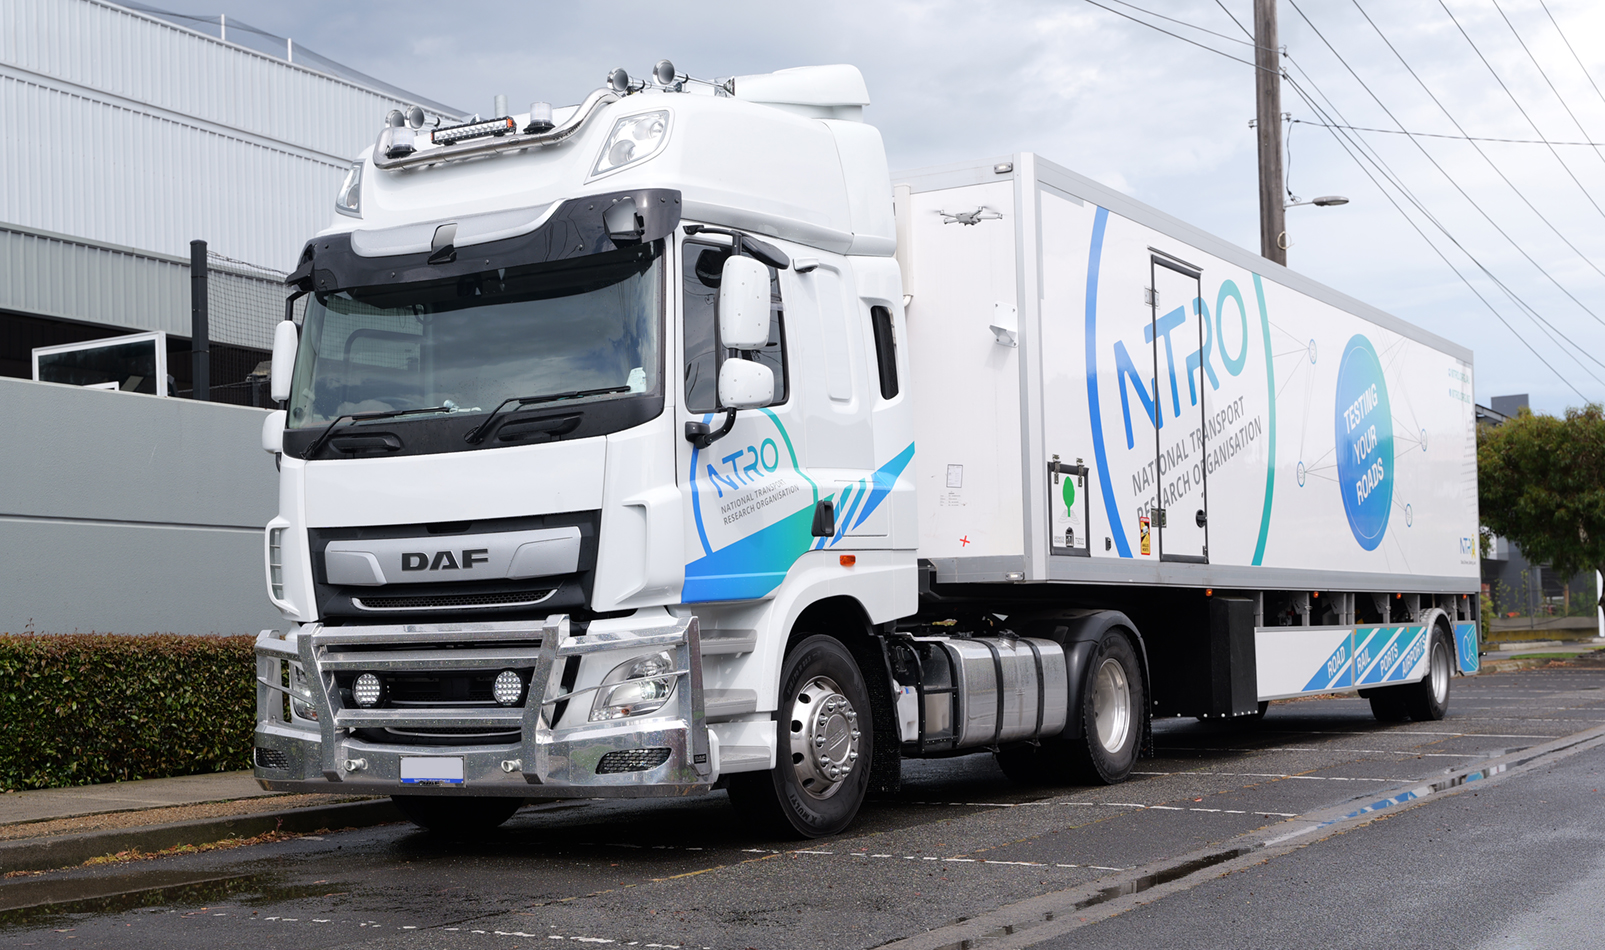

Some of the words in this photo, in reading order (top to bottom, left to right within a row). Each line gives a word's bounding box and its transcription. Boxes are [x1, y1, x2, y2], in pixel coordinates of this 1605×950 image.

[1113, 279, 1248, 450] NTRO
[1189, 395, 1244, 453] TRANSPORT
[1343, 383, 1378, 434] TESTING
[1353, 424, 1378, 465] YOUR
[706, 437, 779, 498] NTRO
[1355, 457, 1384, 506] ROADS
[721, 492, 754, 514] NATIONAL
[754, 479, 787, 499] TRANSPORT
[723, 504, 756, 526] RESEARCH
[756, 484, 800, 510] ORGANISATION
[1137, 470, 1191, 530] RESARCH
[401, 549, 488, 571] DAF
[1327, 646, 1346, 679] ROAD
[1356, 647, 1371, 675] RAIL
[1380, 642, 1399, 677] PORTS
[1402, 634, 1426, 678] AIRPORTS
[789, 793, 810, 821] MULTI
